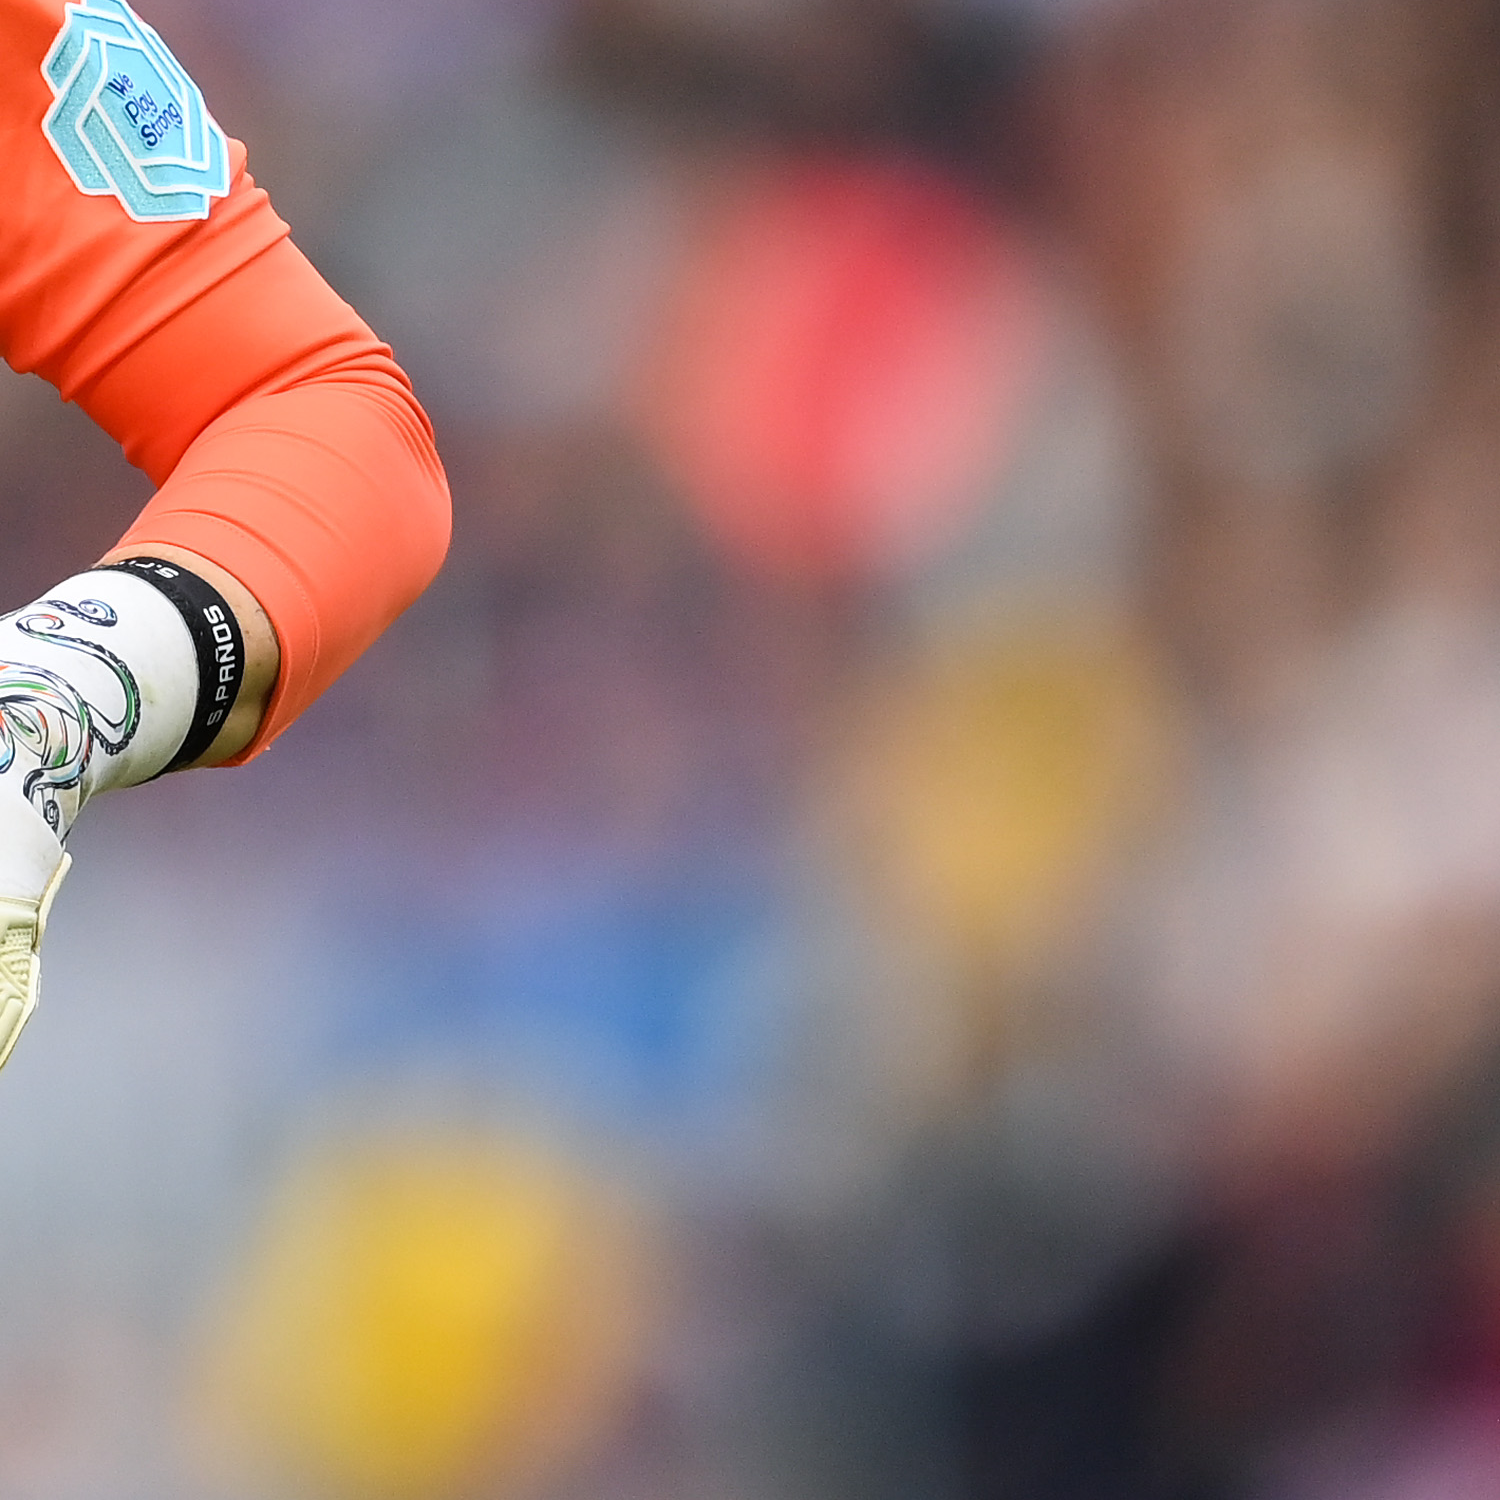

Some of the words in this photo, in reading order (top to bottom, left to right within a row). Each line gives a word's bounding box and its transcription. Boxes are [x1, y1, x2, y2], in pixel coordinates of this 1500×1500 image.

[107, 72, 134, 97] We
[124, 90, 158, 125] Play
[140, 102, 183, 147] Strong
[203, 605, 236, 726] S.PAÑOS
